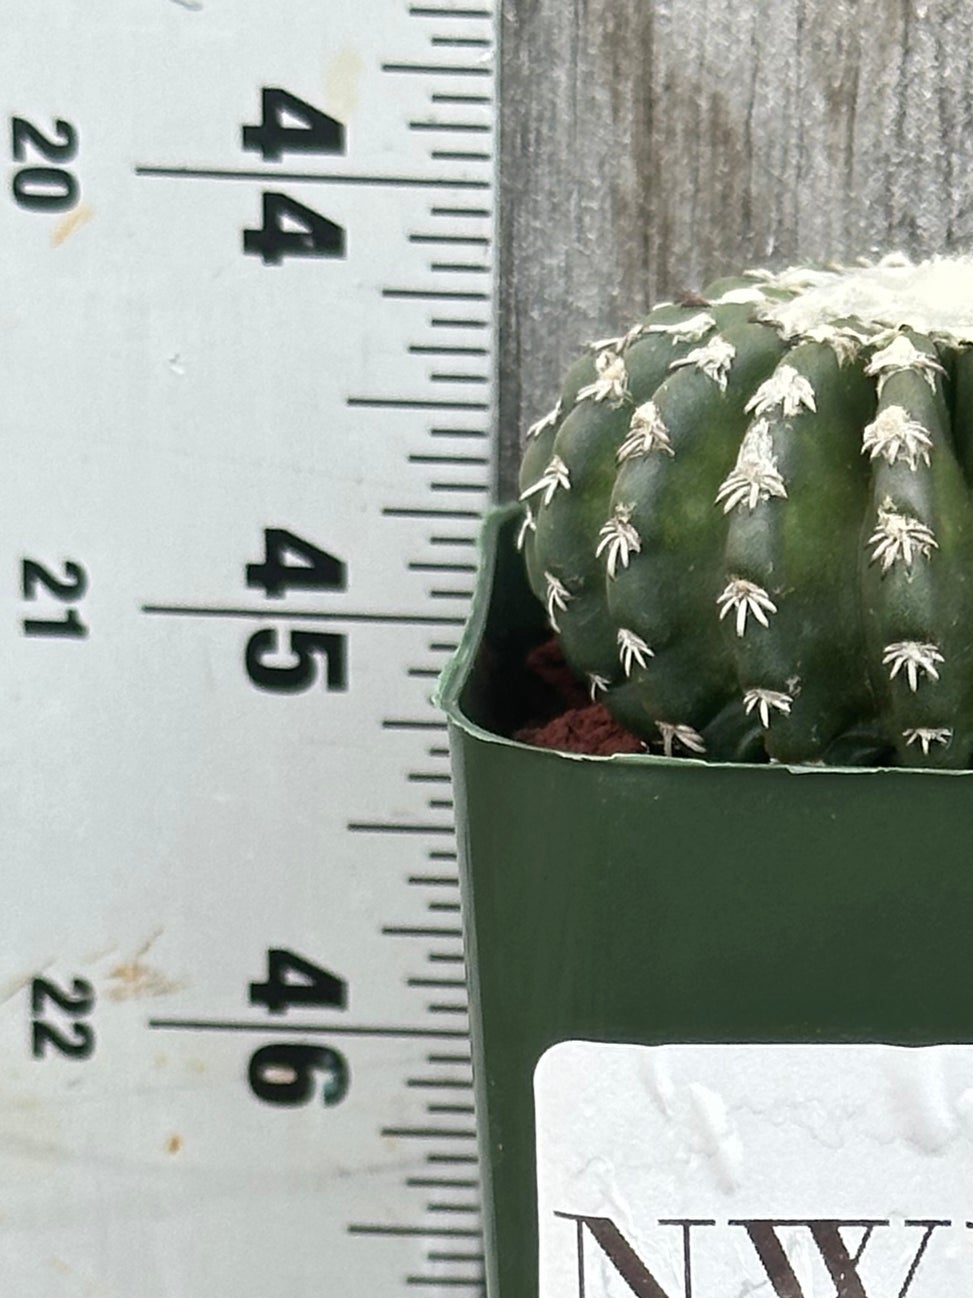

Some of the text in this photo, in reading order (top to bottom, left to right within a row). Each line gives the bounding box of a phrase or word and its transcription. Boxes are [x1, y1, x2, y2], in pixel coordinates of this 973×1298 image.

[12, 116, 76, 210] 20
[22, 558, 86, 637] 21
[31, 977, 94, 1059] 22
